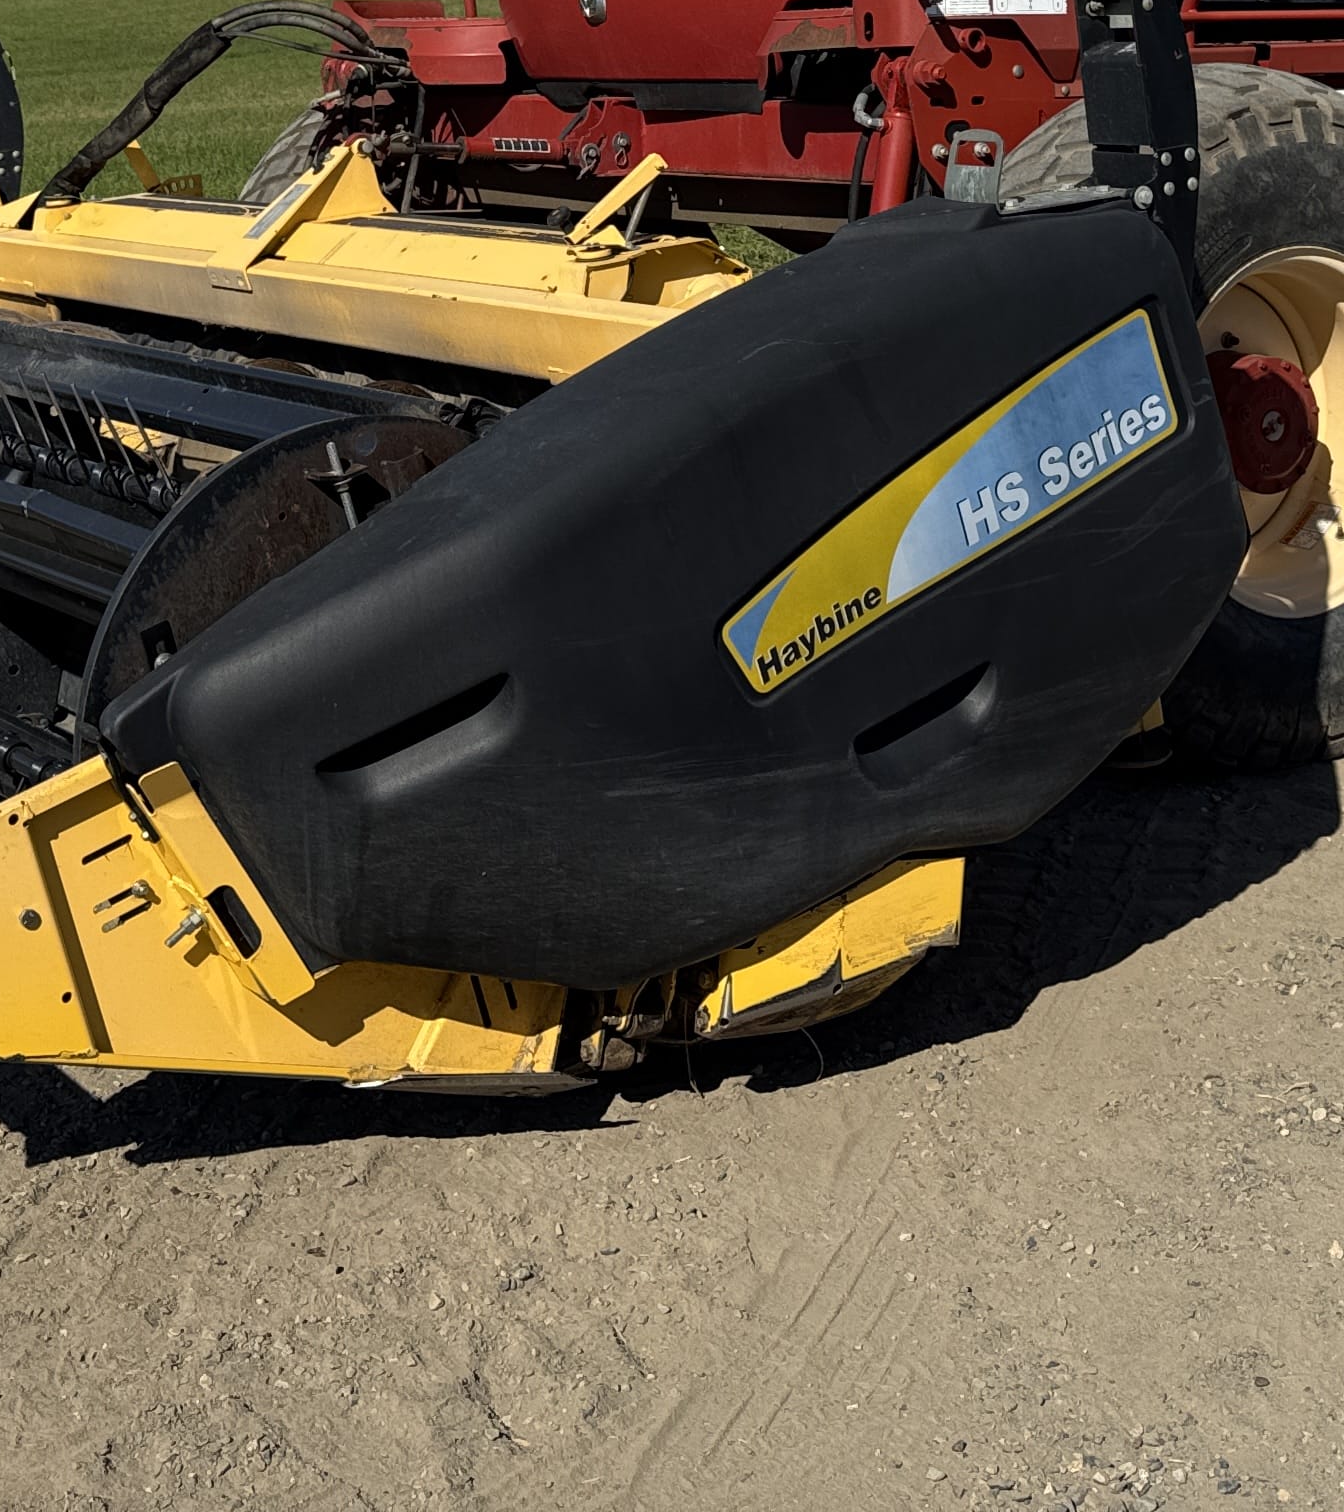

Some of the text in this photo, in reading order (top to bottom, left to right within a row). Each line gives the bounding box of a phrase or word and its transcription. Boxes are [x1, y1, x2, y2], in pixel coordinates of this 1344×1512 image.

[757, 394, 1167, 685] Haybine HS Series
